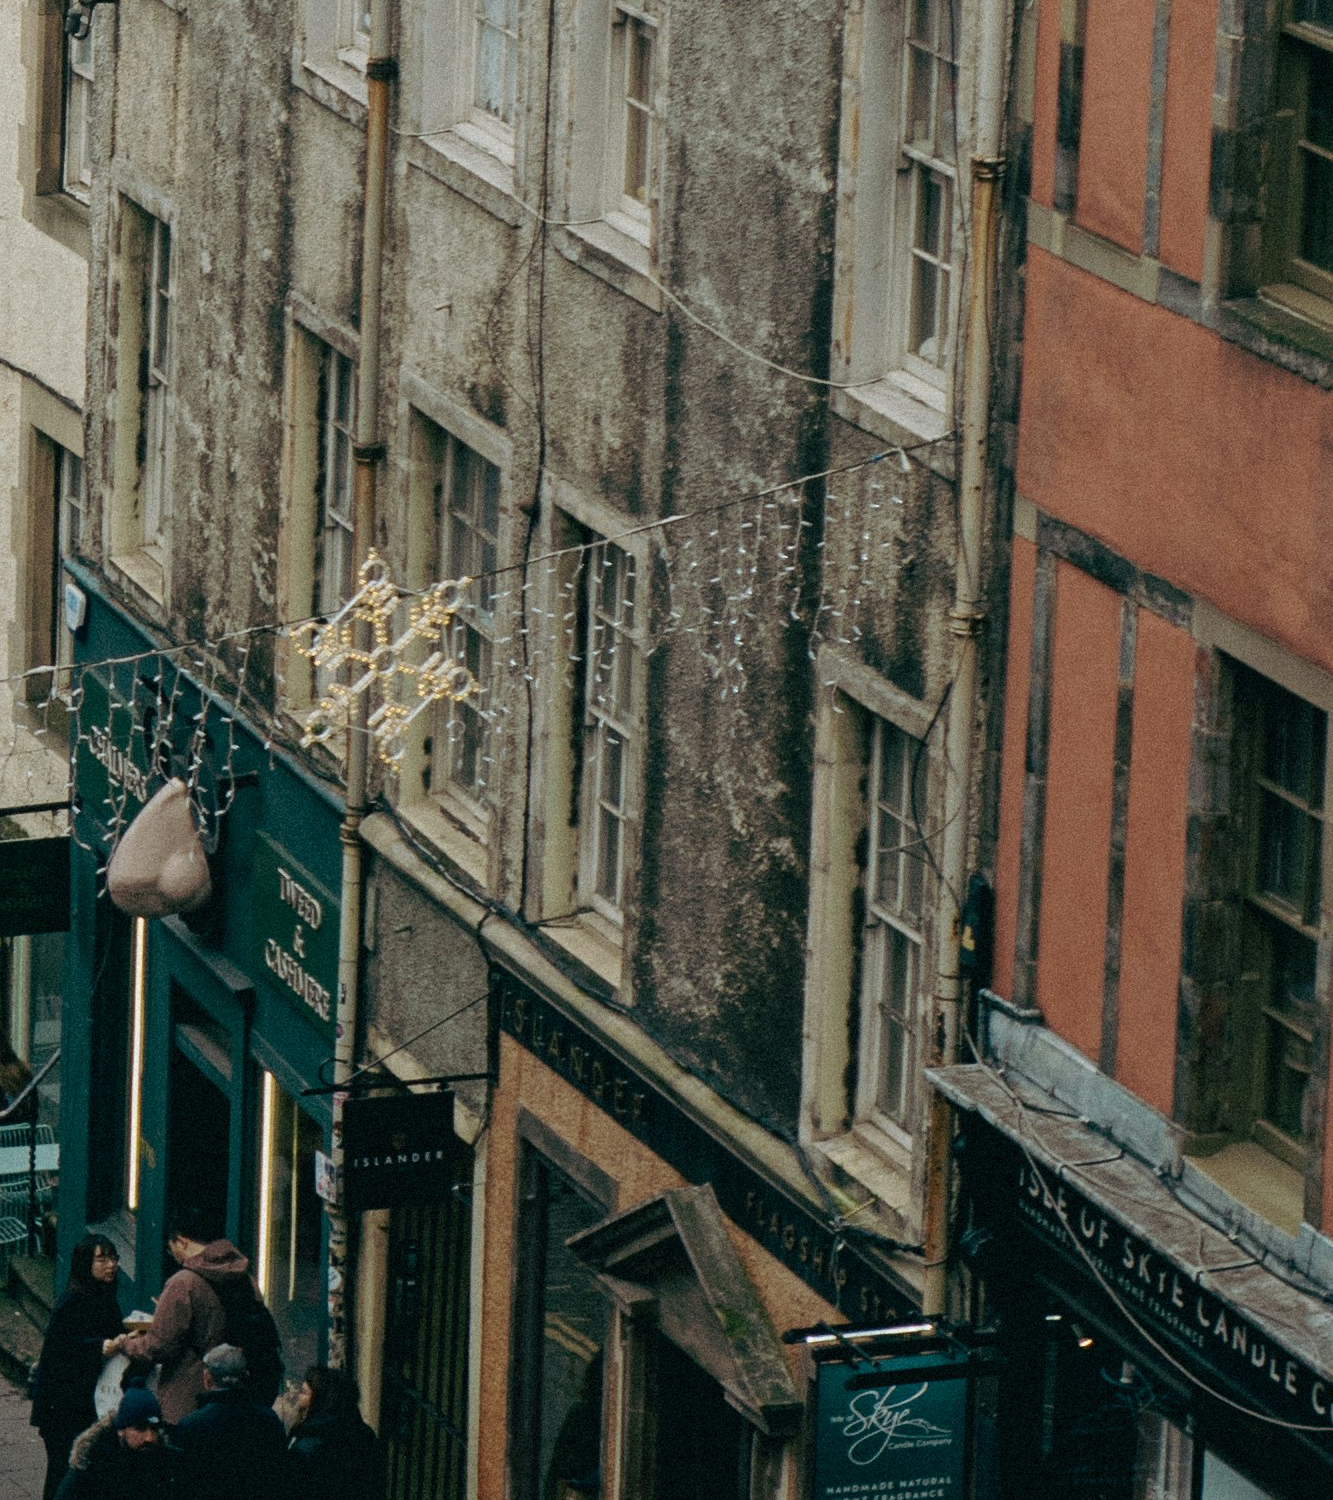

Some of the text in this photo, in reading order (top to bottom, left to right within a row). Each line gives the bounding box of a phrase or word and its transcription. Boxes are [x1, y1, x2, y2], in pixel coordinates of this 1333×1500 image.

[277, 867, 322, 930] TWEED
[265, 937, 331, 1022] CASHMERE
[500, 988, 644, 1116] ISLANDER
[354, 1150, 443, 1168] ISLANDER
[1018, 1168, 1068, 1221] ISLE
[1080, 1207, 1109, 1248] OF
[1123, 1237, 1185, 1308] SKYE
[1196, 1295, 1298, 1396] CANDLE
[1147, 1299, 1205, 1348] FRAGRANCE
[843, 1382, 929, 1466] Skye
[916, 1438, 952, 1448] Company
[826, 1475, 952, 1495] HANDMADE NATURAL
